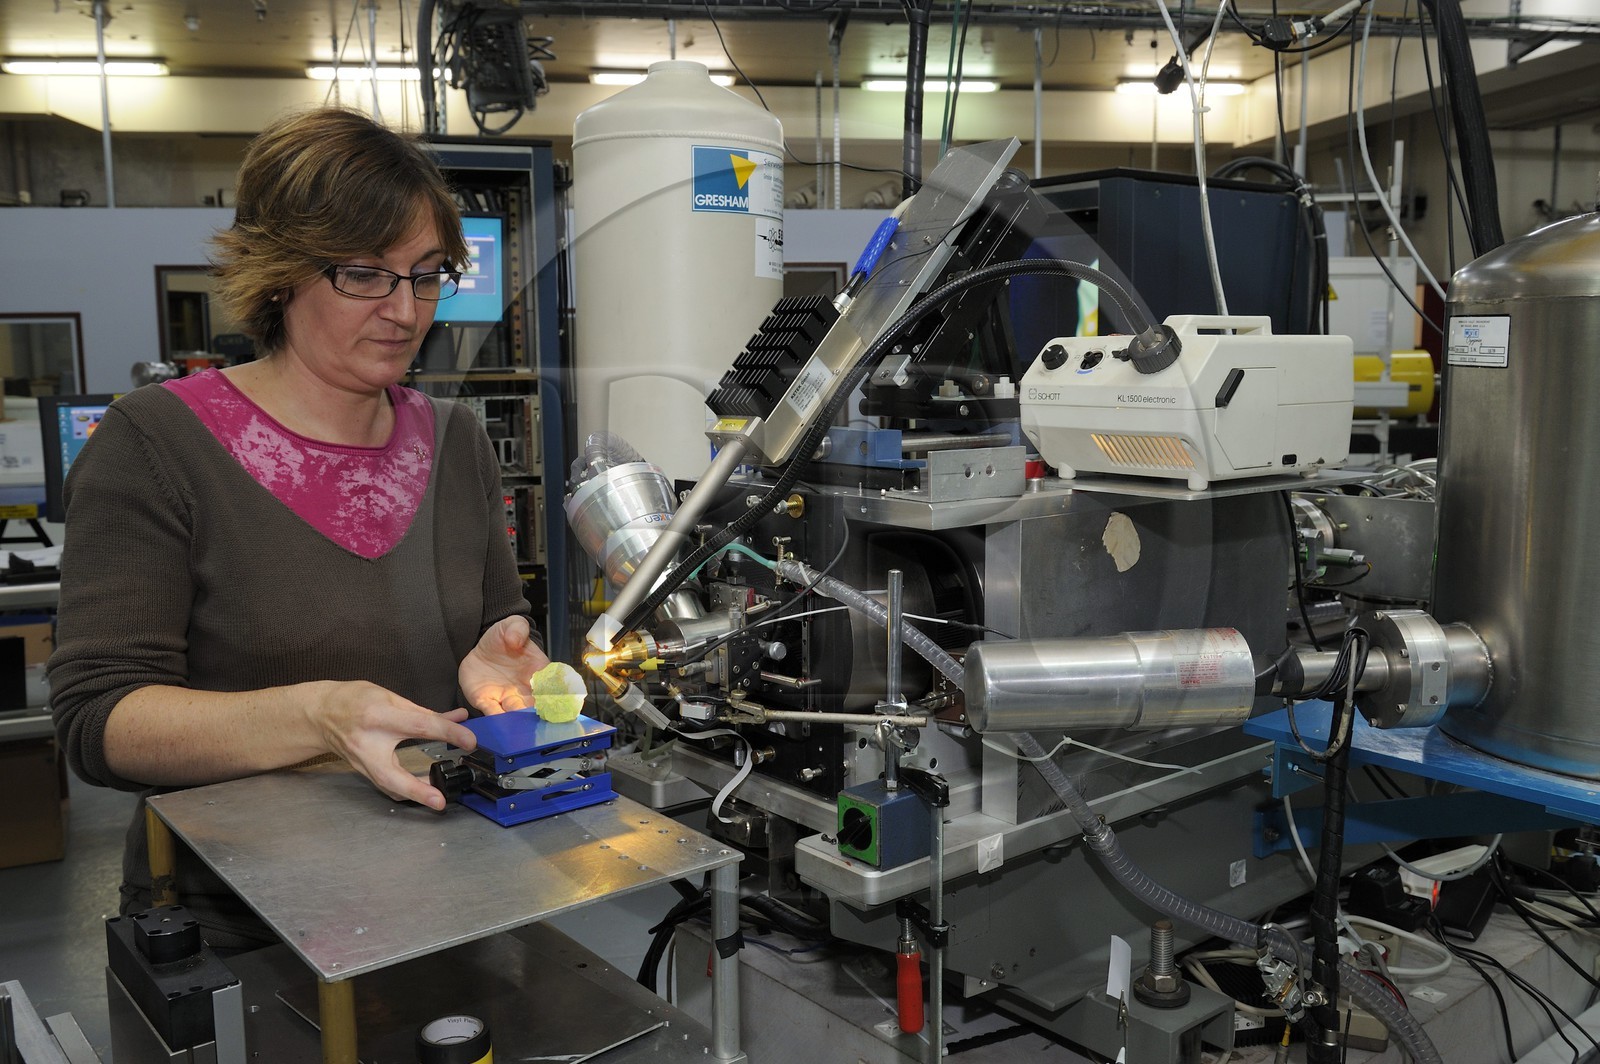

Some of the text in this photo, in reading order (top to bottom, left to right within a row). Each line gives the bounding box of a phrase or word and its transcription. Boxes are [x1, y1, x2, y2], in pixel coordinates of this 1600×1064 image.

[694, 193, 749, 209] GRESHAM
[1037, 392, 1061, 401] SCHOTT
[1142, 395, 1176, 404] electronic
